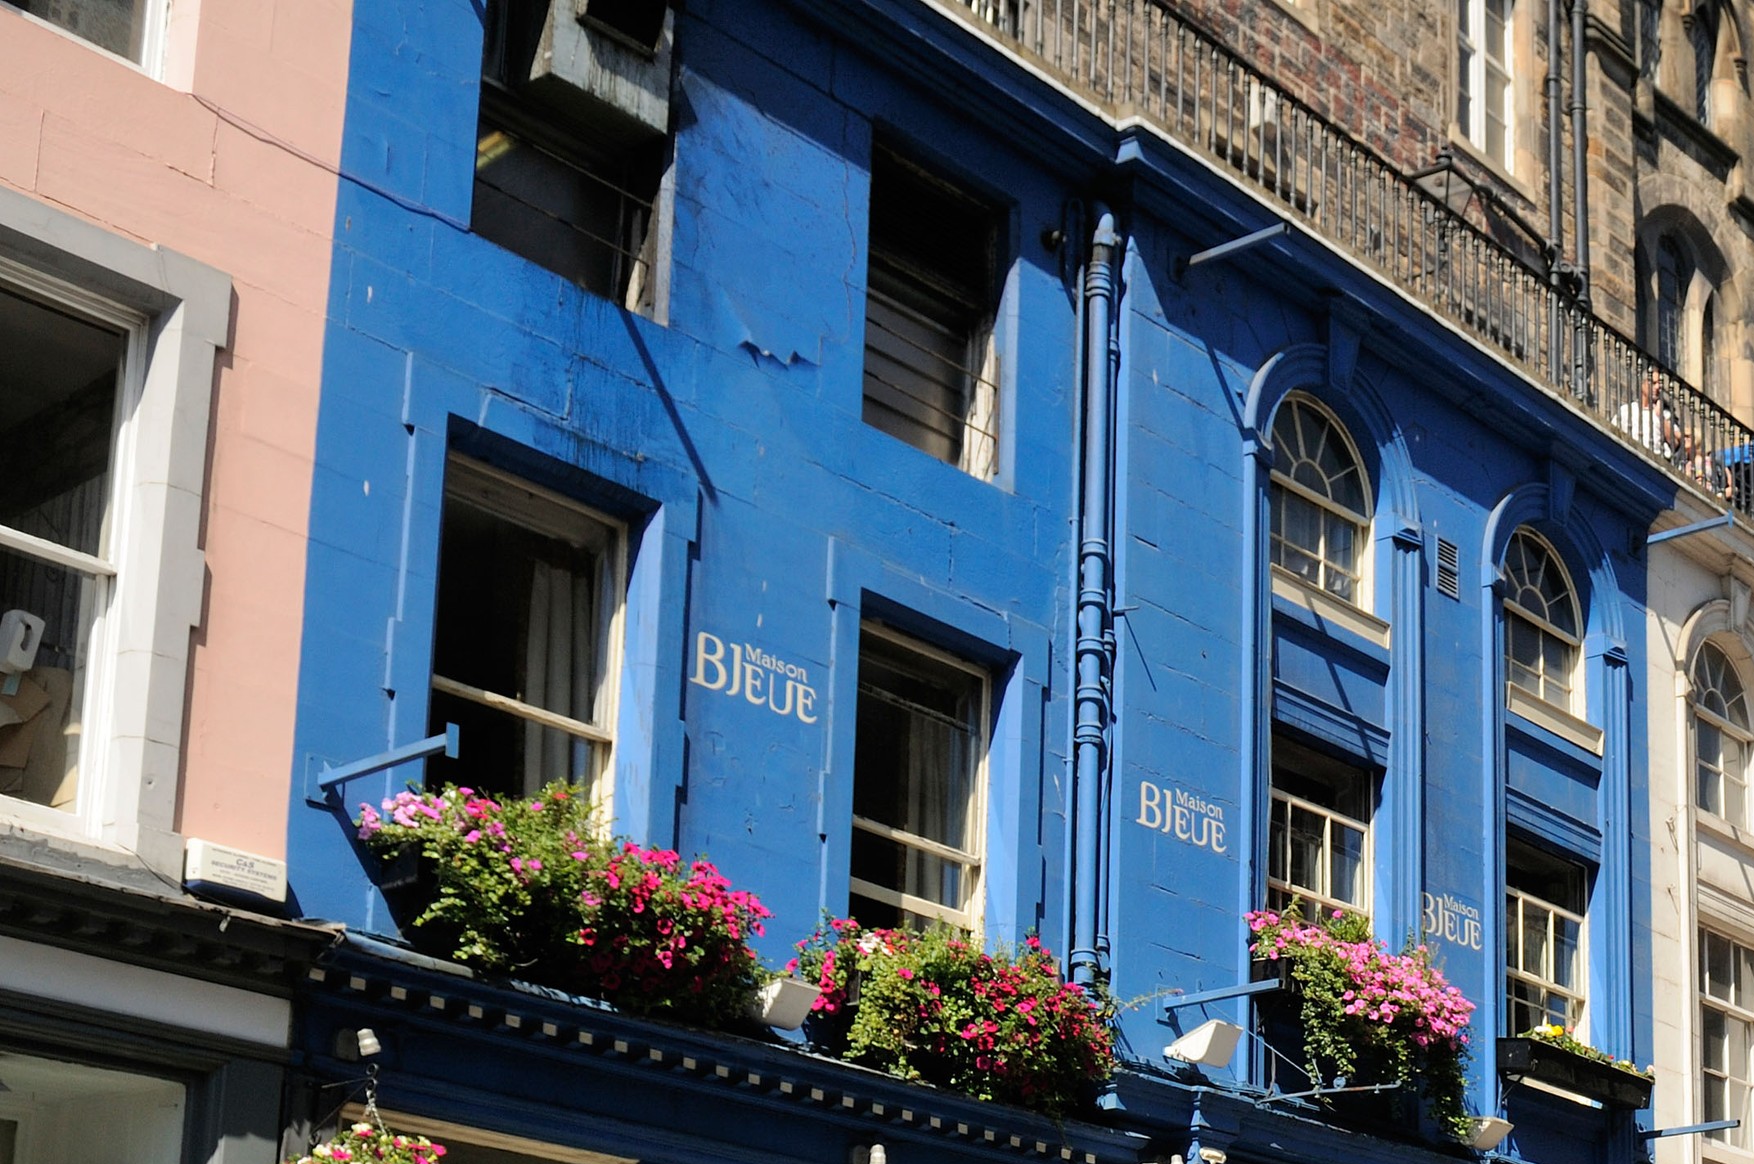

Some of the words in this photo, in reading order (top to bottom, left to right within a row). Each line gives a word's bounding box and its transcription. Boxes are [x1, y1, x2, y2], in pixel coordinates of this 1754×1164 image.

[745, 643, 808, 684] Maison
[1175, 788, 1224, 820] Maison
[1443, 893, 1479, 921] Maison
